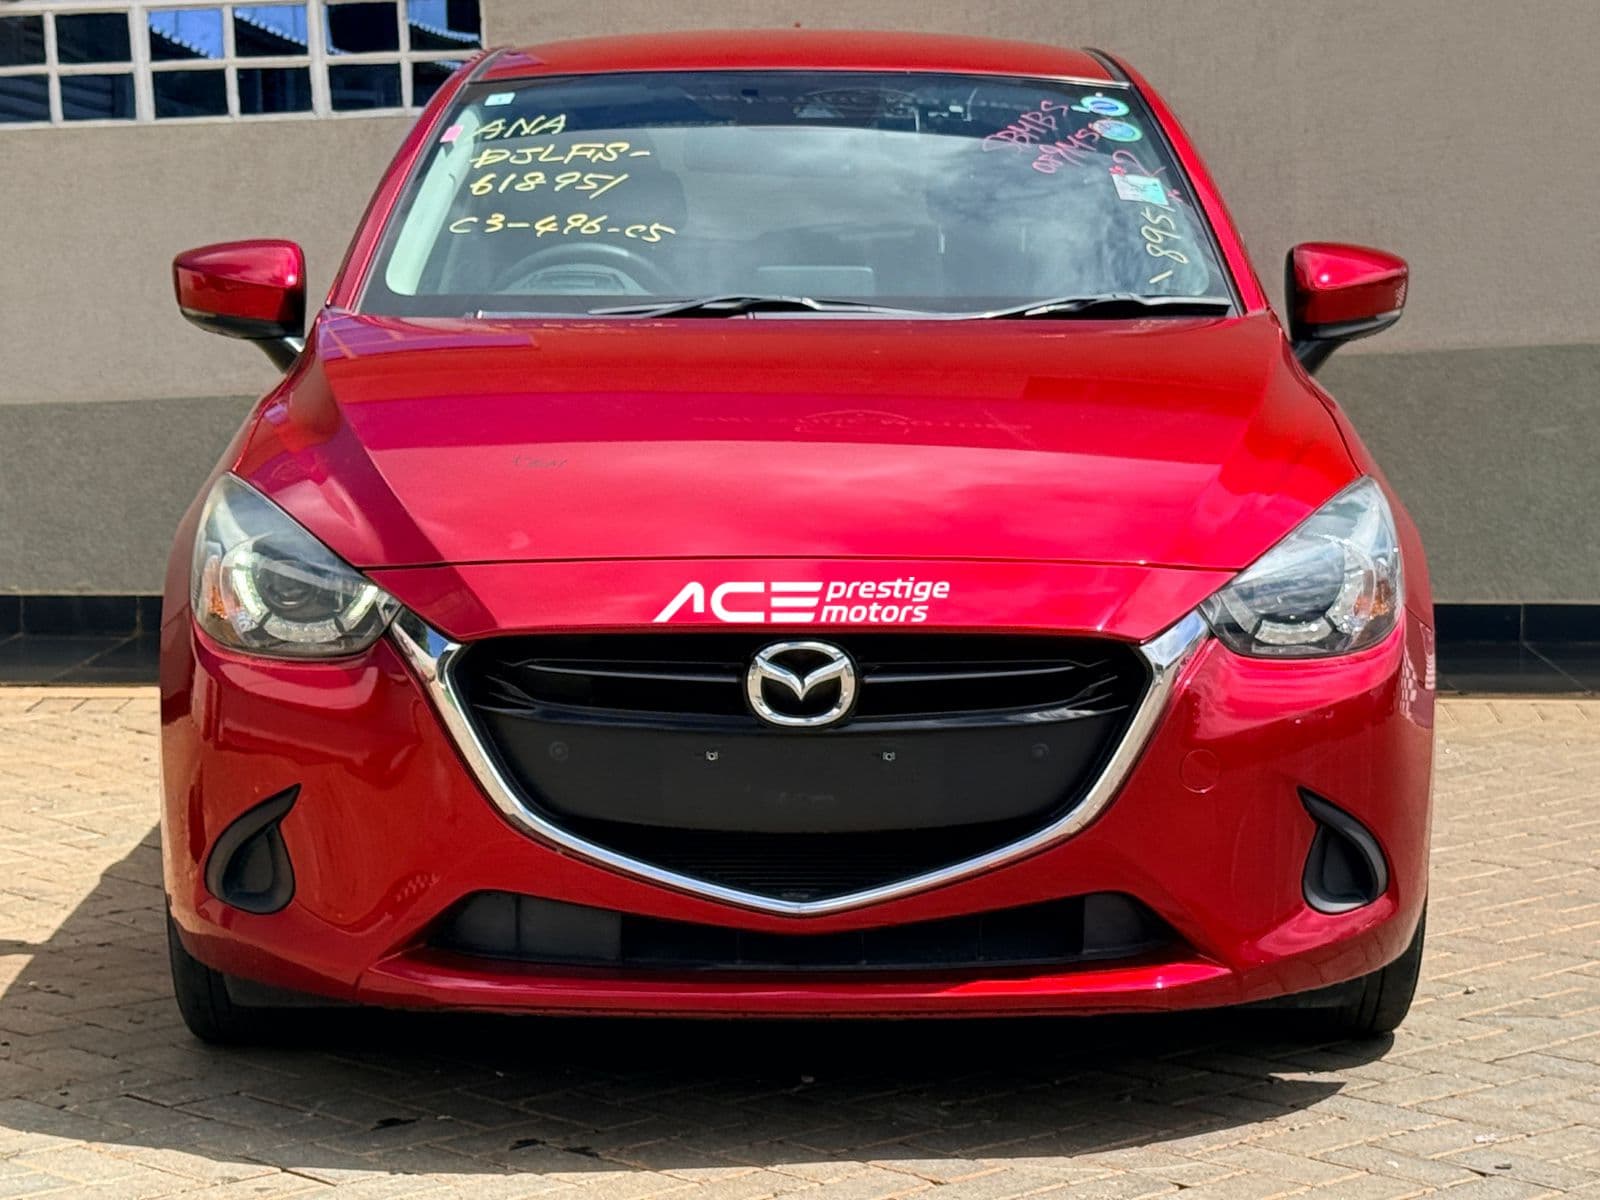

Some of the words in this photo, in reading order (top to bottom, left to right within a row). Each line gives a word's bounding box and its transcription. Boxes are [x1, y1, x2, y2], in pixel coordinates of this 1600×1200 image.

[652, 581, 823, 623] ACE
[826, 577, 950, 603] prestige
[820, 603, 928, 623] motors
